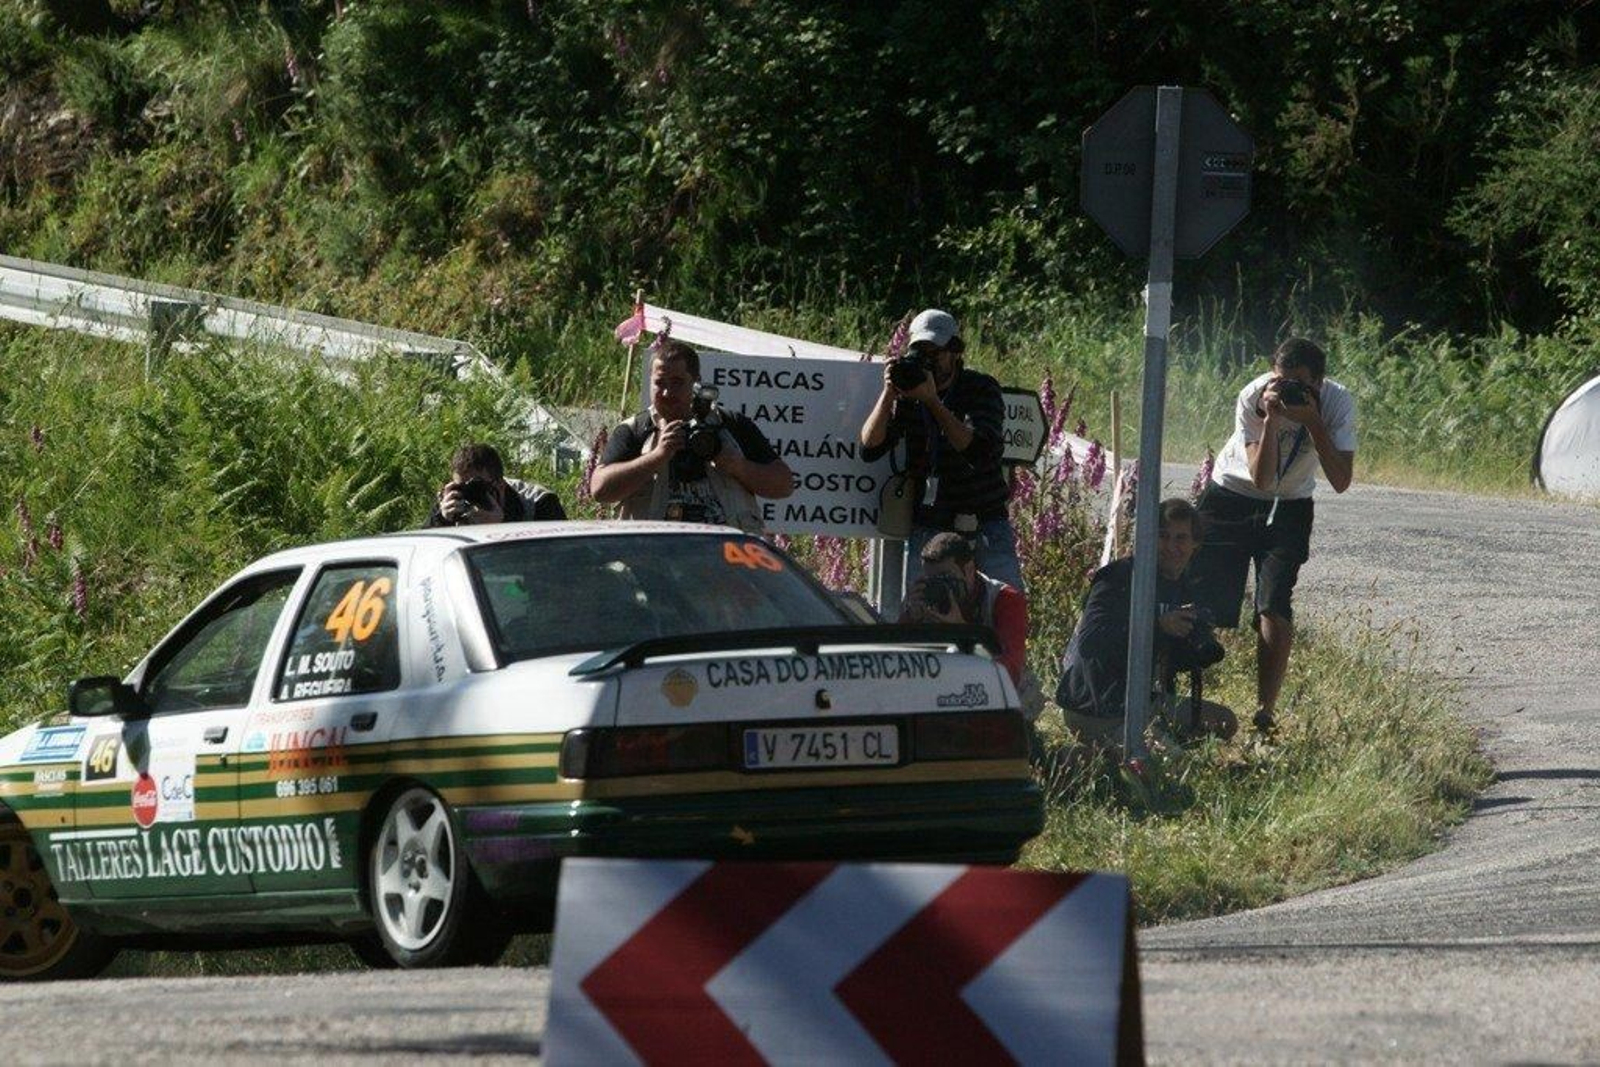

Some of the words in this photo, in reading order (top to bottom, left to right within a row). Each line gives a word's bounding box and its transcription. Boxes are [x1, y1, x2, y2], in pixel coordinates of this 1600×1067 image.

[713, 368, 824, 391] ESTACAS
[785, 504, 879, 526] MAGIN
[722, 540, 783, 573] 46
[325, 576, 391, 643] 46
[312, 649, 355, 674] SOUTO
[706, 660, 771, 688] CASA
[777, 656, 809, 684] DO
[814, 652, 941, 681] AMERICANO
[89, 737, 118, 773] 46
[762, 733, 777, 762] V
[791, 731, 849, 762] 7451
[863, 731, 892, 760] CL
[50, 838, 145, 882] TALLERES
[141, 828, 207, 878] LAGE
[207, 822, 326, 876] CUSTODIO
